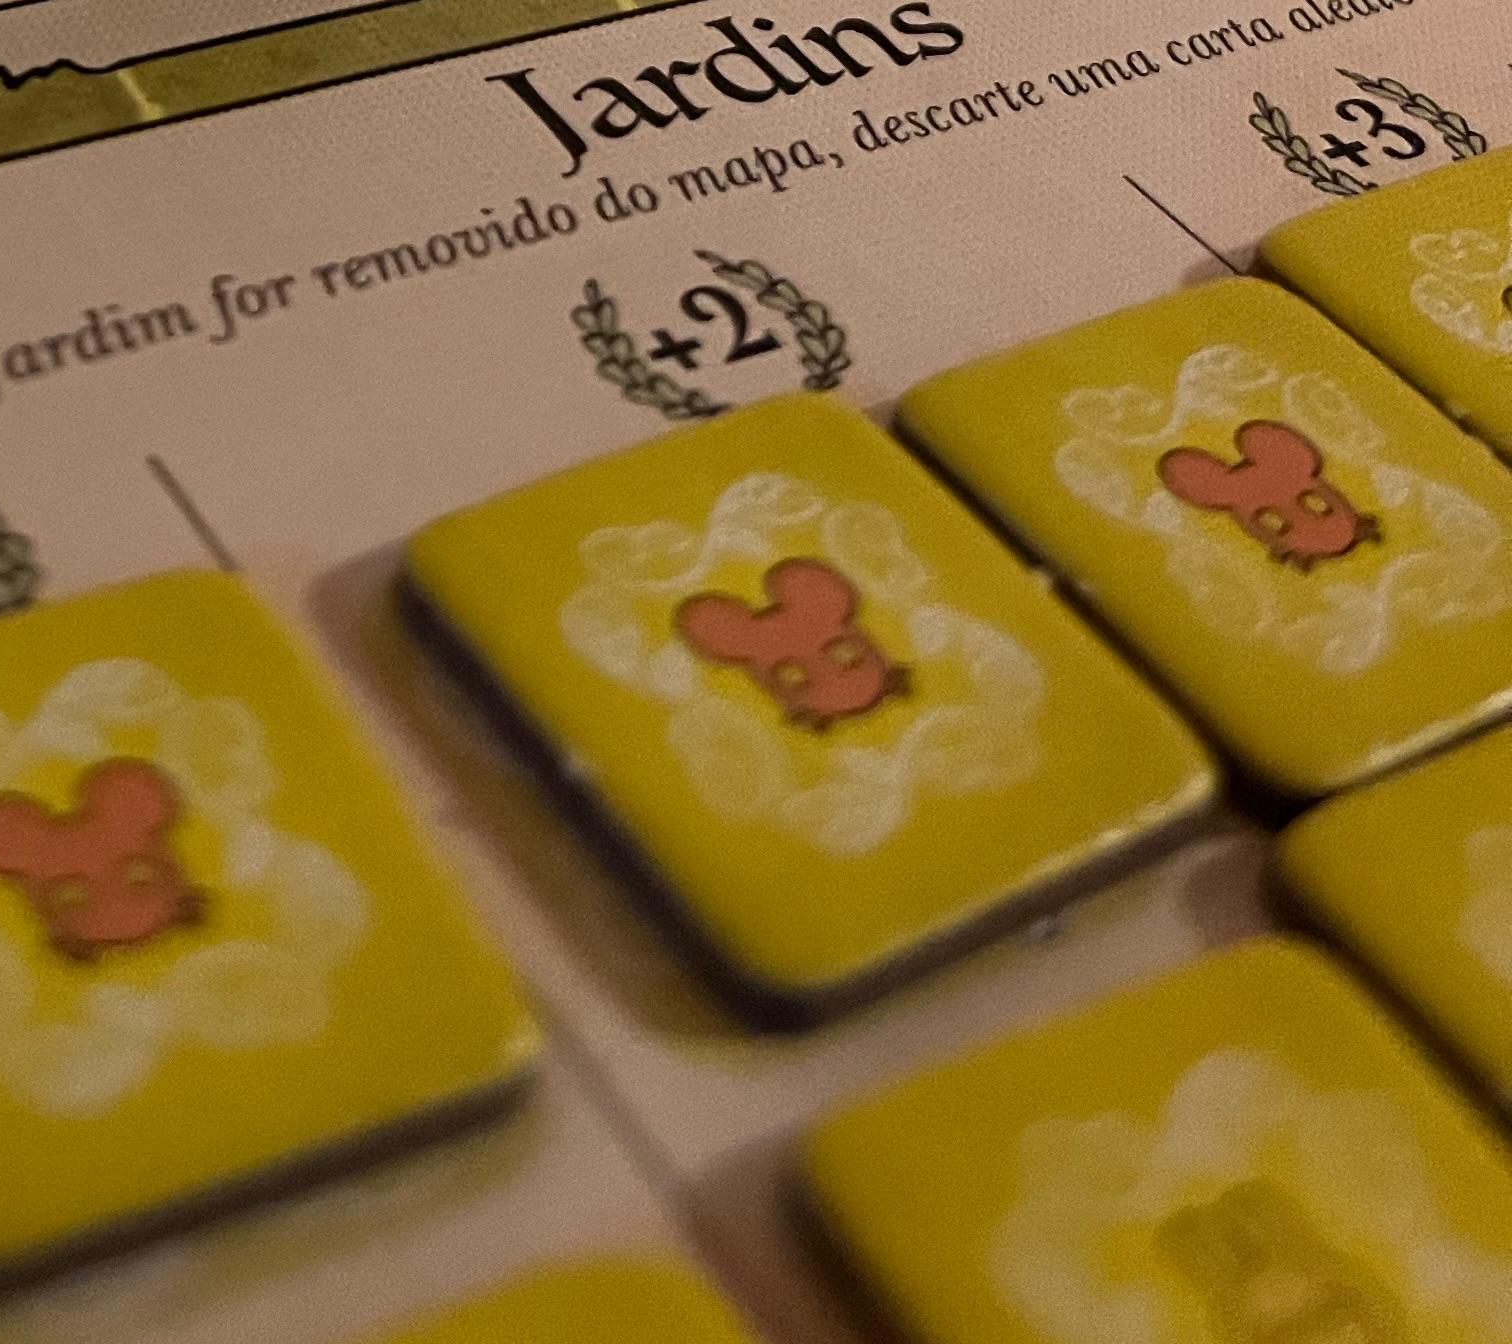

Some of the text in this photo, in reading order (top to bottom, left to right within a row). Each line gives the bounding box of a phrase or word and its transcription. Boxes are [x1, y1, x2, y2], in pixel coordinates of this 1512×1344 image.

[485, 1, 965, 178] Jardins
[1320, 97, 1428, 169] +3
[209, 273, 299, 346] for
[309, 195, 579, 299] removido
[593, 176, 660, 224] do
[668, 132, 845, 193] mapa,
[851, 76, 1044, 155] descarte
[1048, 46, 1161, 97] uma
[1166, 16, 1285, 65] carta
[648, 283, 782, 370] +2
